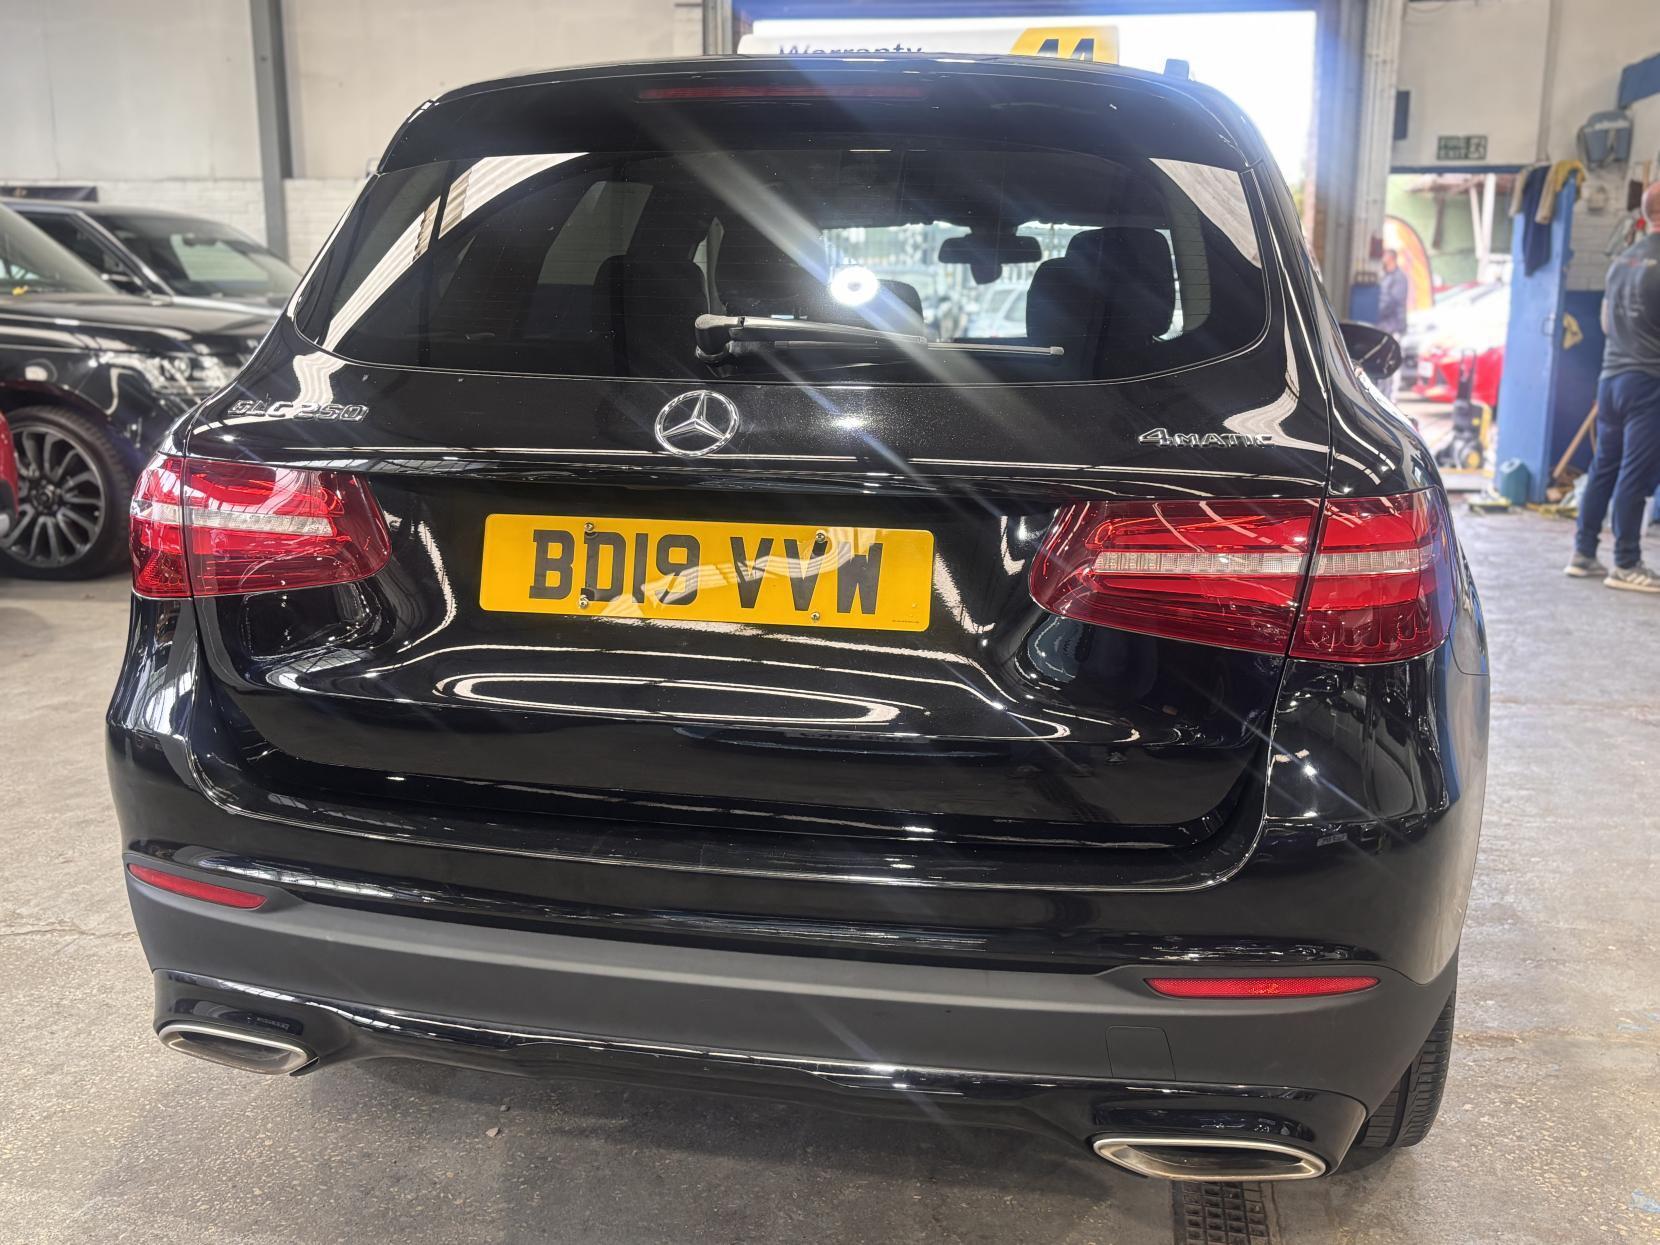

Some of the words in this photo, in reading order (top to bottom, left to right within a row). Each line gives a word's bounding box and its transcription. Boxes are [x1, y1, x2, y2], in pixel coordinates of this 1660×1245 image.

[228, 399, 293, 418] GLC
[293, 402, 370, 423] 250
[1138, 427, 1275, 448] 4MATIC
[528, 529, 701, 606] BD19
[729, 536, 884, 615] VVW
